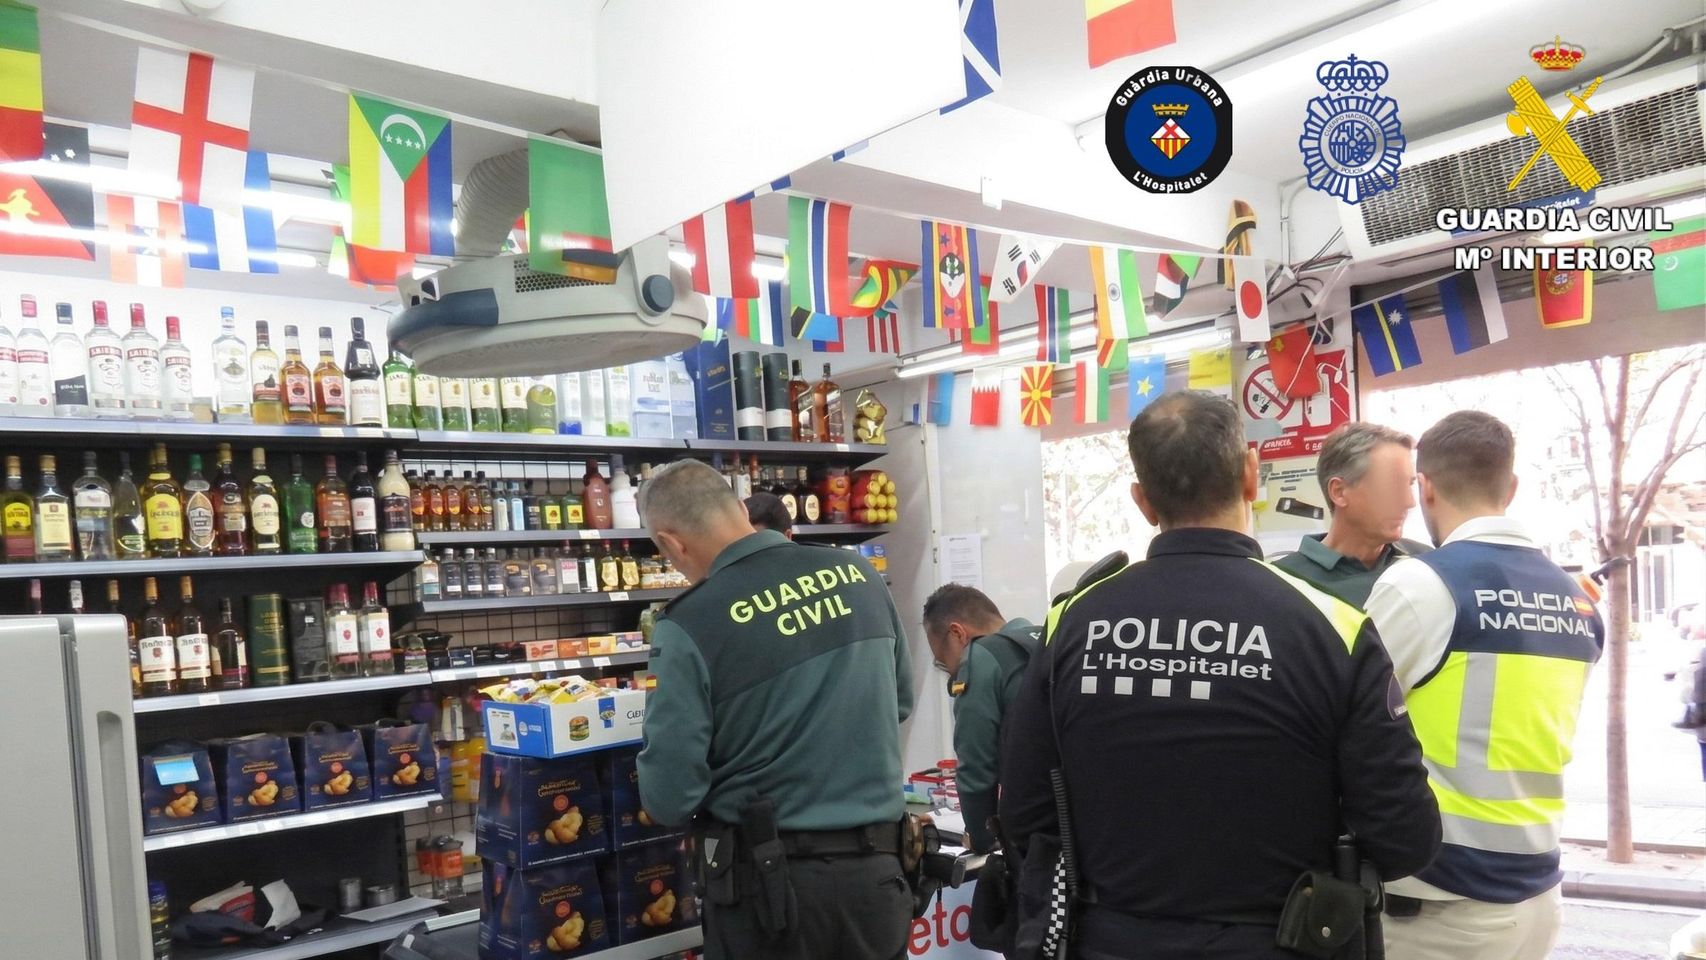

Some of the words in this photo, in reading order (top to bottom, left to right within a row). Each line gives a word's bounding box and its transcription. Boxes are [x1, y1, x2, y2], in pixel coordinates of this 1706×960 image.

[730, 563, 867, 624] GUARDIA
[1474, 589, 1577, 612] POLICIA
[776, 594, 852, 637] CIVIL
[1479, 612, 1596, 638] NACIONAL
[1085, 617, 1273, 659] POLICIA
[1082, 653, 1272, 682] L'Hospitalet
